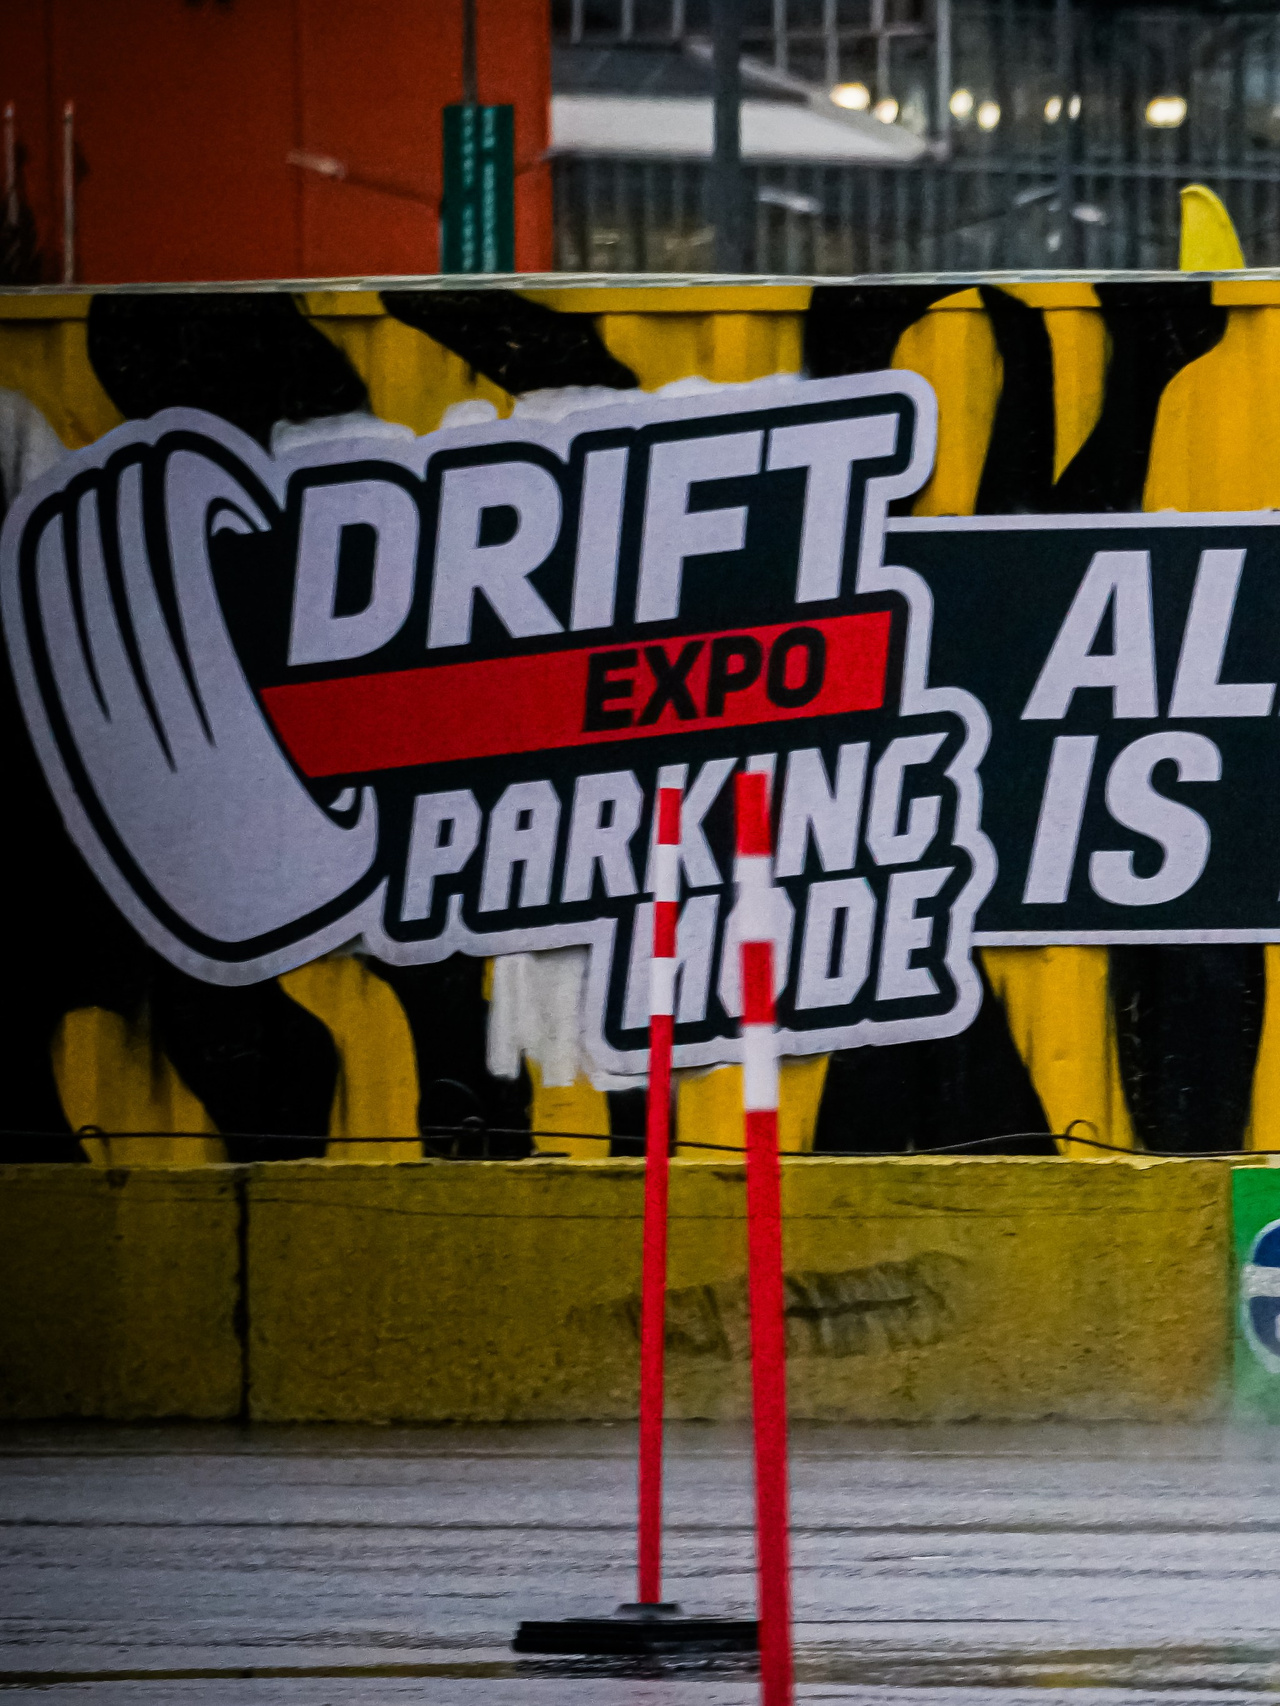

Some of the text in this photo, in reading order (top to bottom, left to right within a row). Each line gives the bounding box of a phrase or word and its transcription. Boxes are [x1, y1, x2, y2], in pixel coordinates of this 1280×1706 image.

[287, 412, 898, 667] DRIFT
[581, 627, 827, 734] EXPO
[400, 732, 949, 923] PARKNG
[1023, 732, 1221, 906] IS
